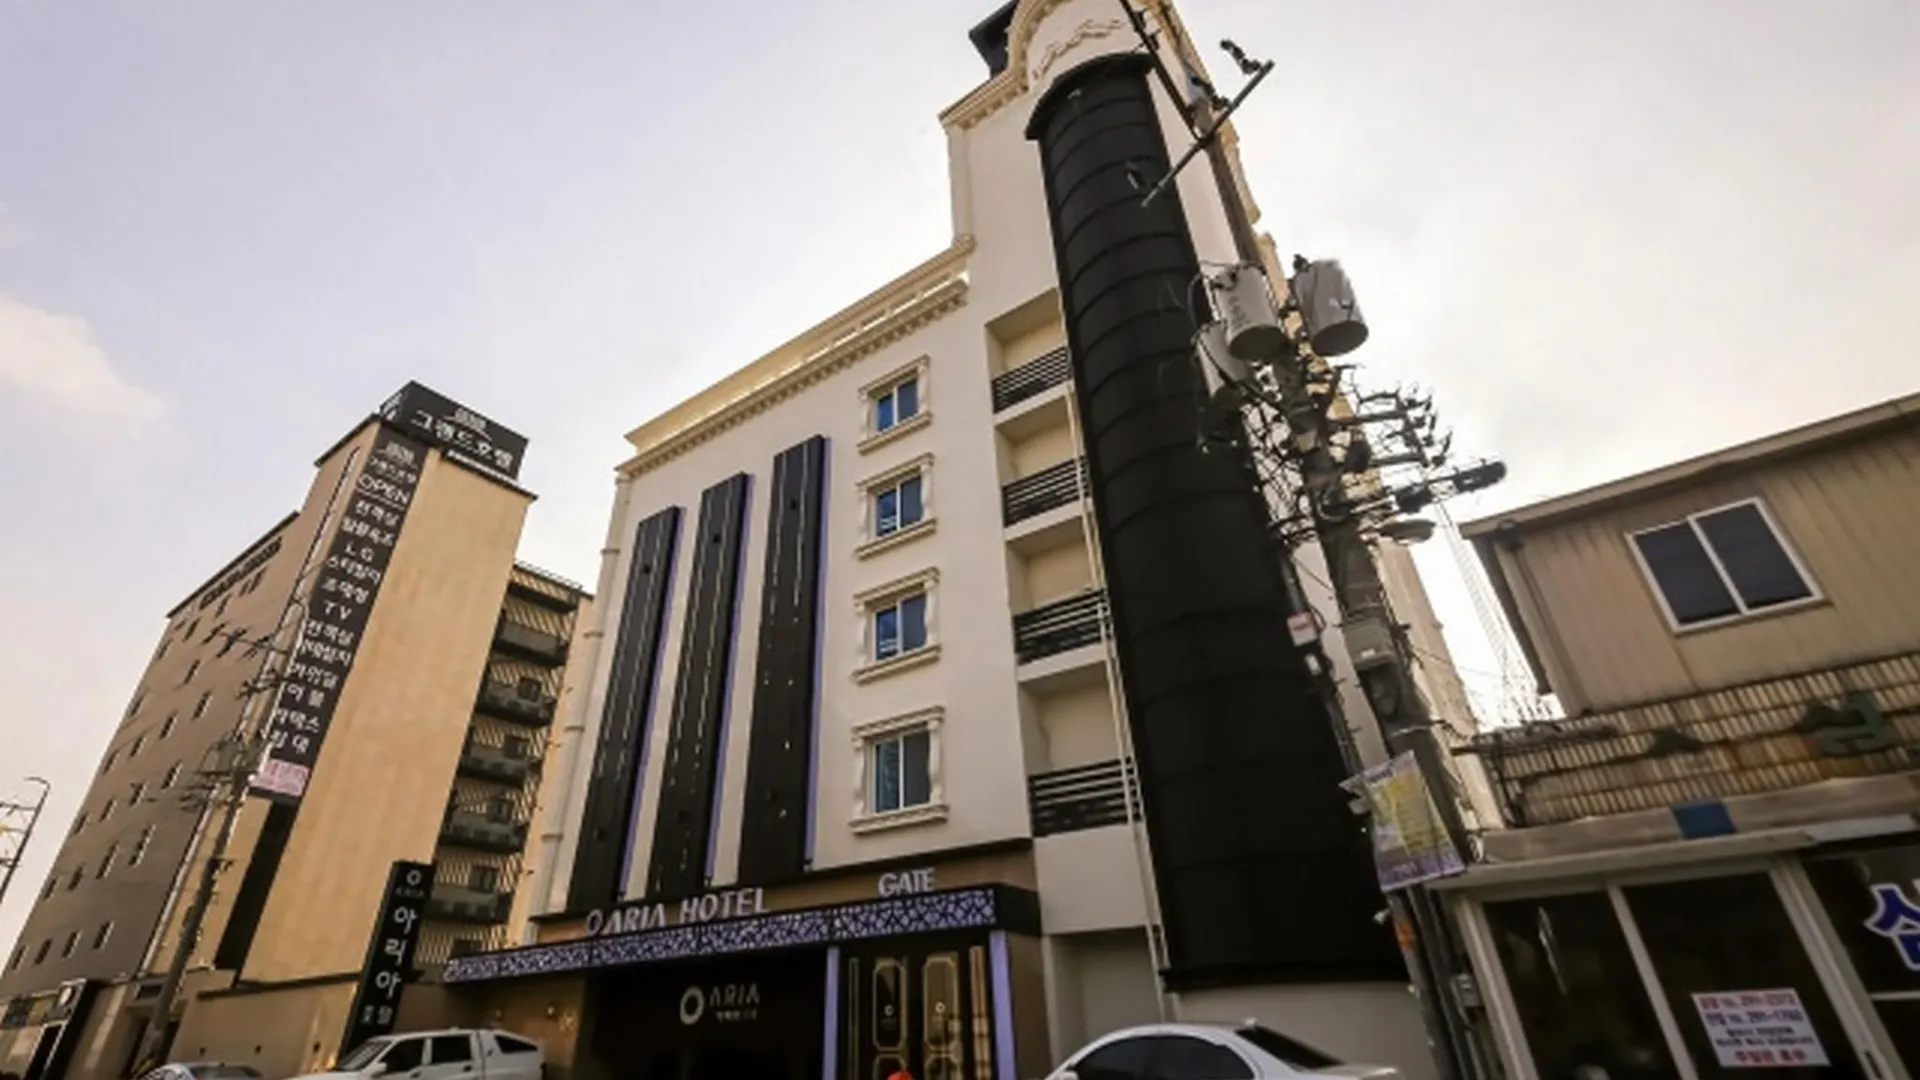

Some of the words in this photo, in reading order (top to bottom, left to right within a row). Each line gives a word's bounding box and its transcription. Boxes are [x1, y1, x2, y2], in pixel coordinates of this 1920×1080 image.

[358, 473, 411, 505] OPEN
[324, 600, 353, 620] TV
[878, 867, 936, 898] GATE
[601, 902, 667, 937] ARIA
[679, 887, 771, 925] HOTEL
[709, 983, 761, 1008] ARIA
